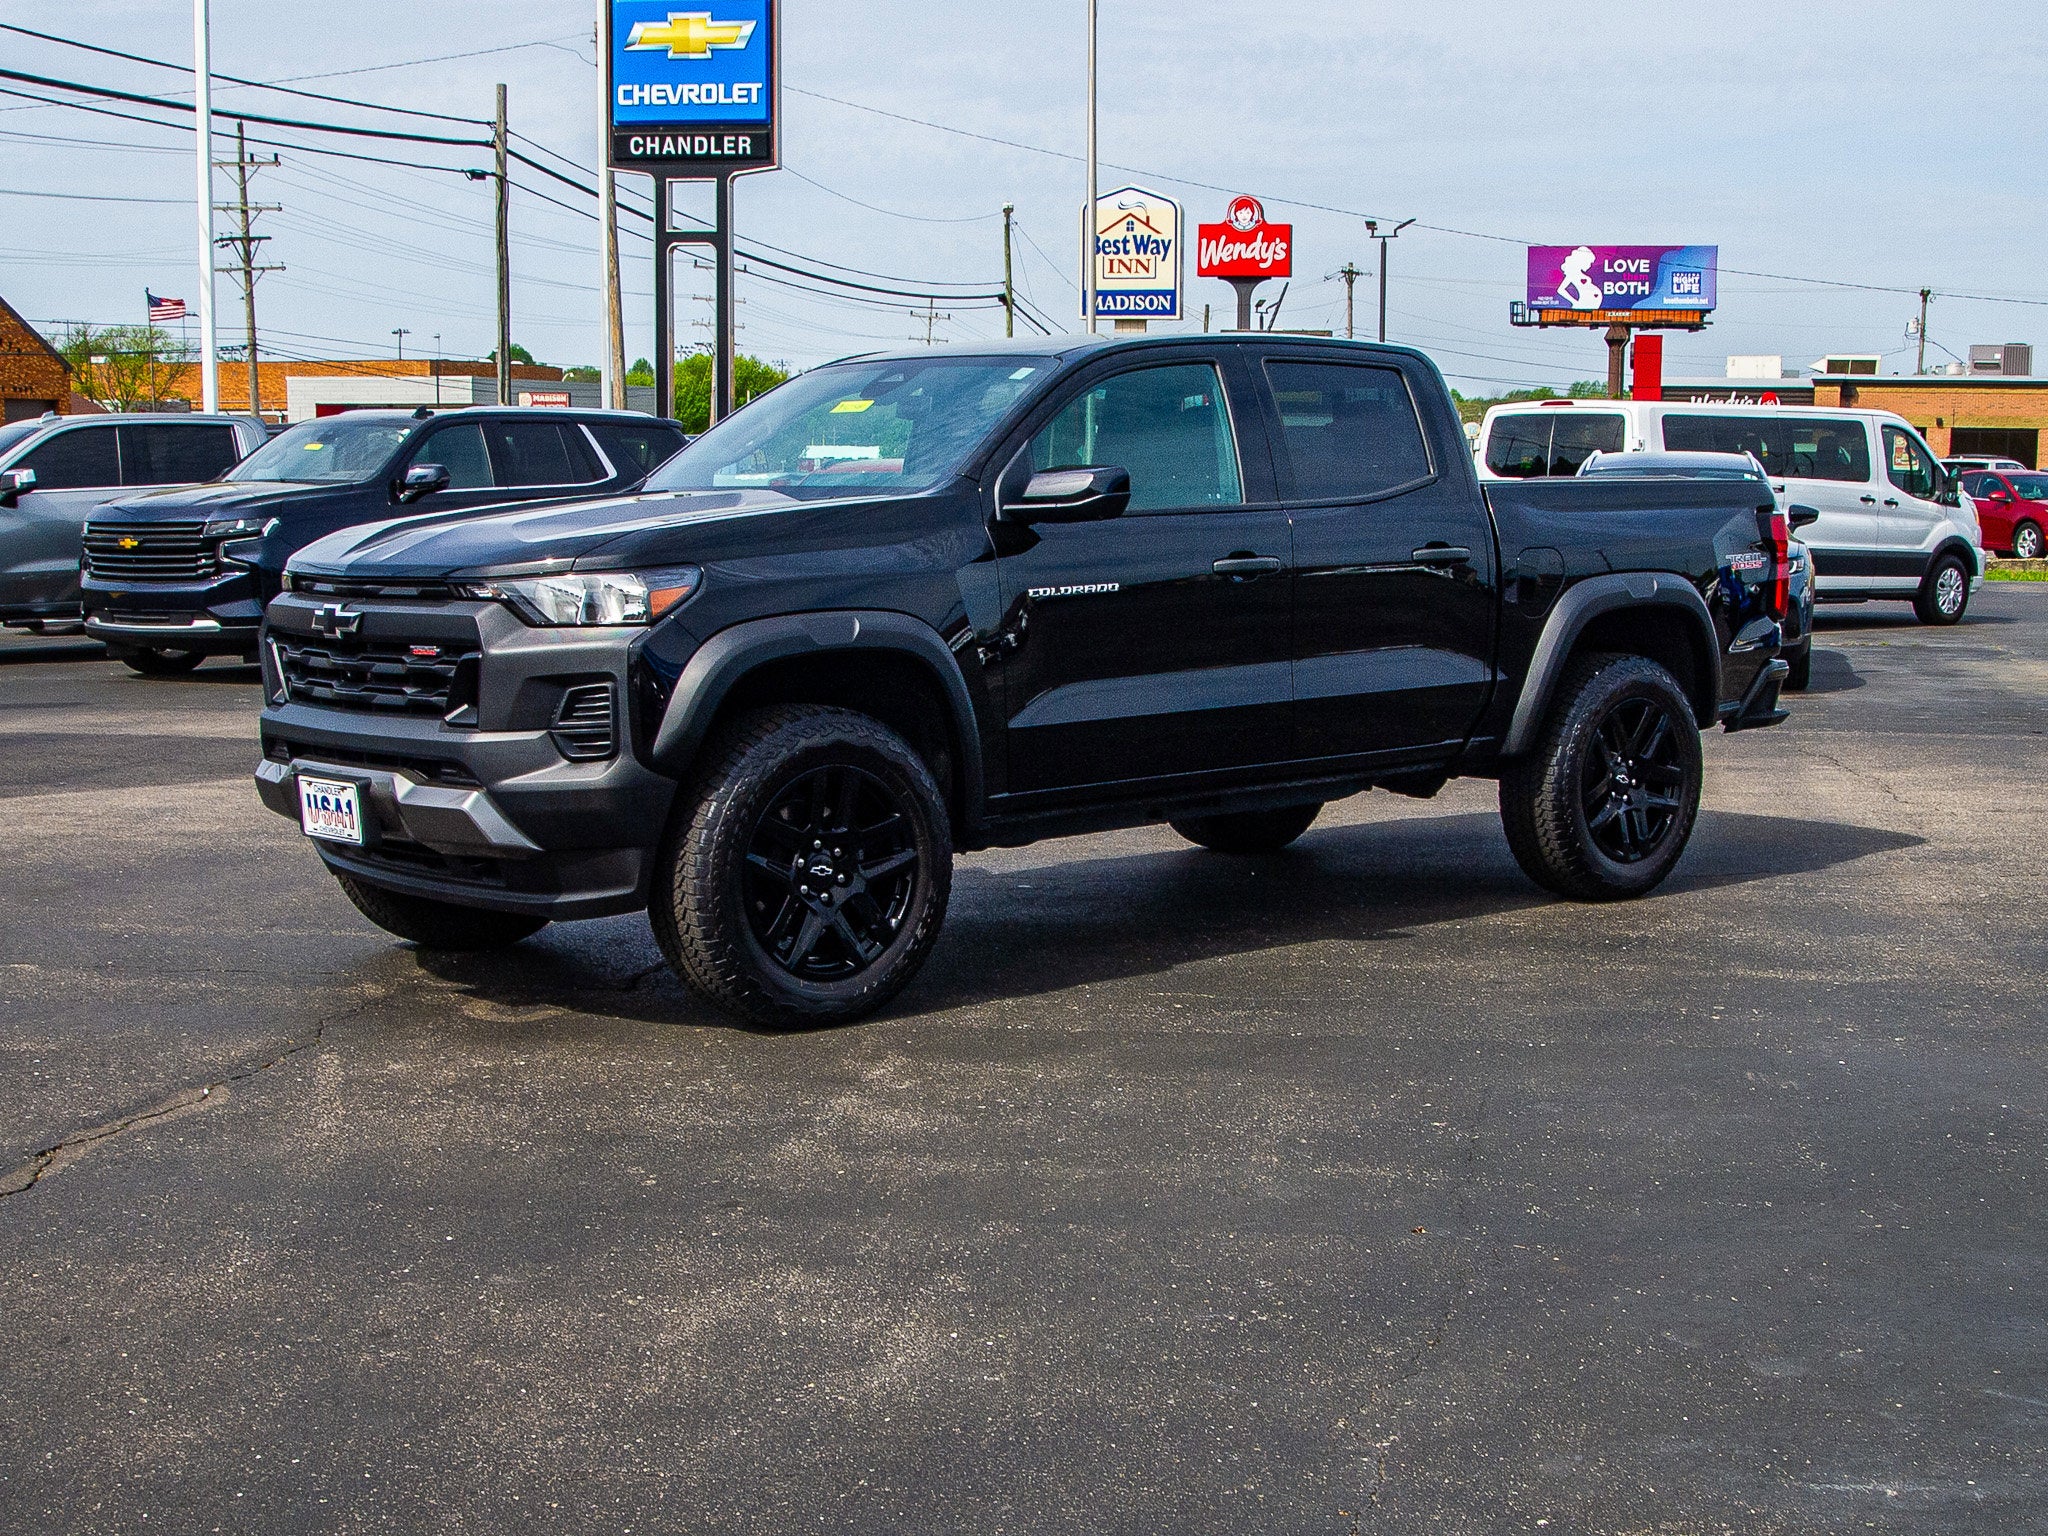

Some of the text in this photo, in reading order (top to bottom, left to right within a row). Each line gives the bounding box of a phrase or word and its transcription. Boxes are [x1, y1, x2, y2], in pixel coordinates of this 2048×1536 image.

[617, 82, 763, 106] CHEVROLET
[629, 135, 752, 156] CHANDLER
[1133, 234, 1172, 262] Way
[1200, 231, 1287, 269] Wendy's
[1107, 258, 1151, 274] INN
[1604, 258, 1650, 273] LOVE
[1622, 272, 1649, 281] them
[1672, 276, 1700, 284] RIGHT
[1603, 281, 1650, 295] BOTH
[1672, 283, 1700, 294] LIFE
[532, 394, 567, 402] MADISON
[1725, 552, 1767, 563] TRAIL
[1731, 560, 1763, 571] BOSS
[1028, 582, 1120, 598] COLORADO
